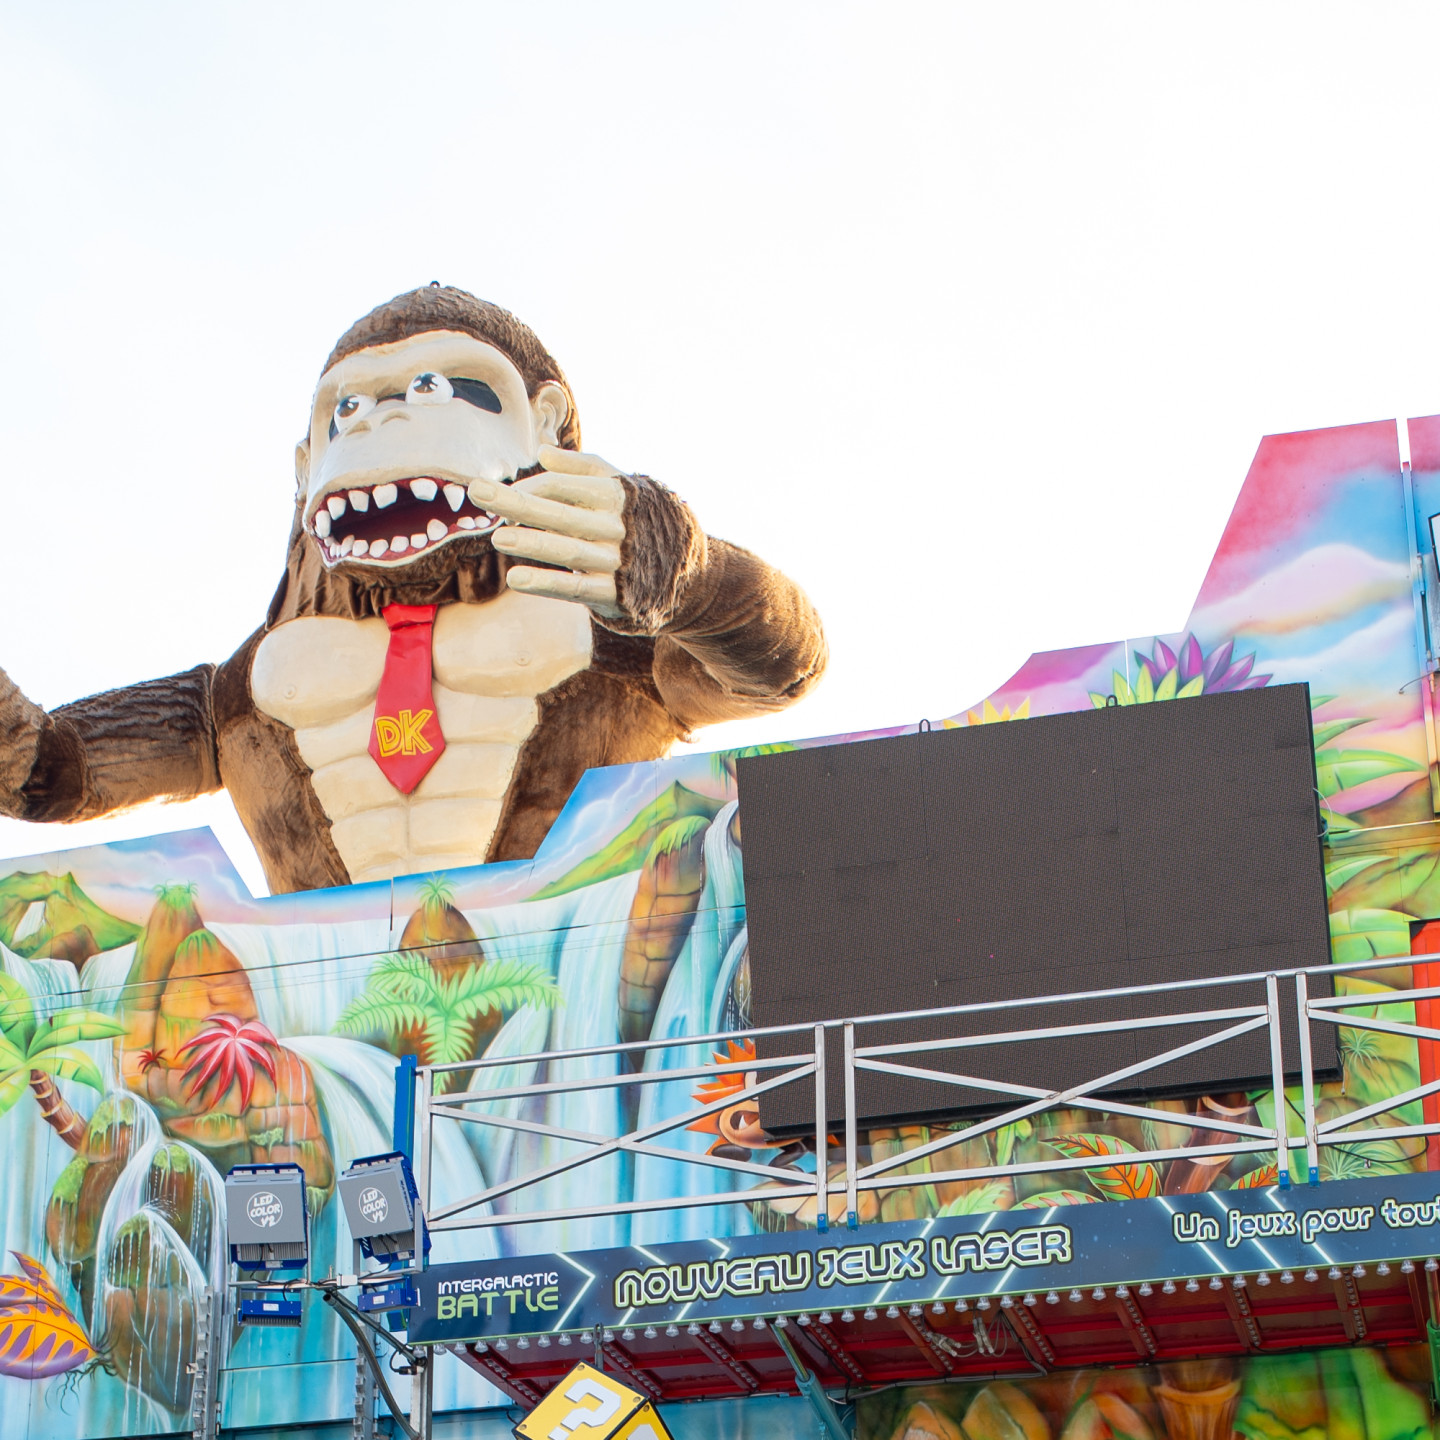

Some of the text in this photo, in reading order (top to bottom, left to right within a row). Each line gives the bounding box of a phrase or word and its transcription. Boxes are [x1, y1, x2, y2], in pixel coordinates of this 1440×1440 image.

[375, 709, 434, 757] DK
[253, 1194, 273, 1207] LED
[362, 1199, 386, 1215] COLOR
[363, 1190, 378, 1203] LED
[250, 1203, 281, 1218] COLOR
[1173, 1213, 1219, 1242] Un
[1227, 1210, 1296, 1248] jeux
[1302, 1205, 1374, 1242] pour
[615, 1226, 1072, 1308] NOUVEAU JEUX LASER
[438, 1272, 559, 1294] INTERGALACTIC
[437, 1286, 559, 1320] BATTLE
